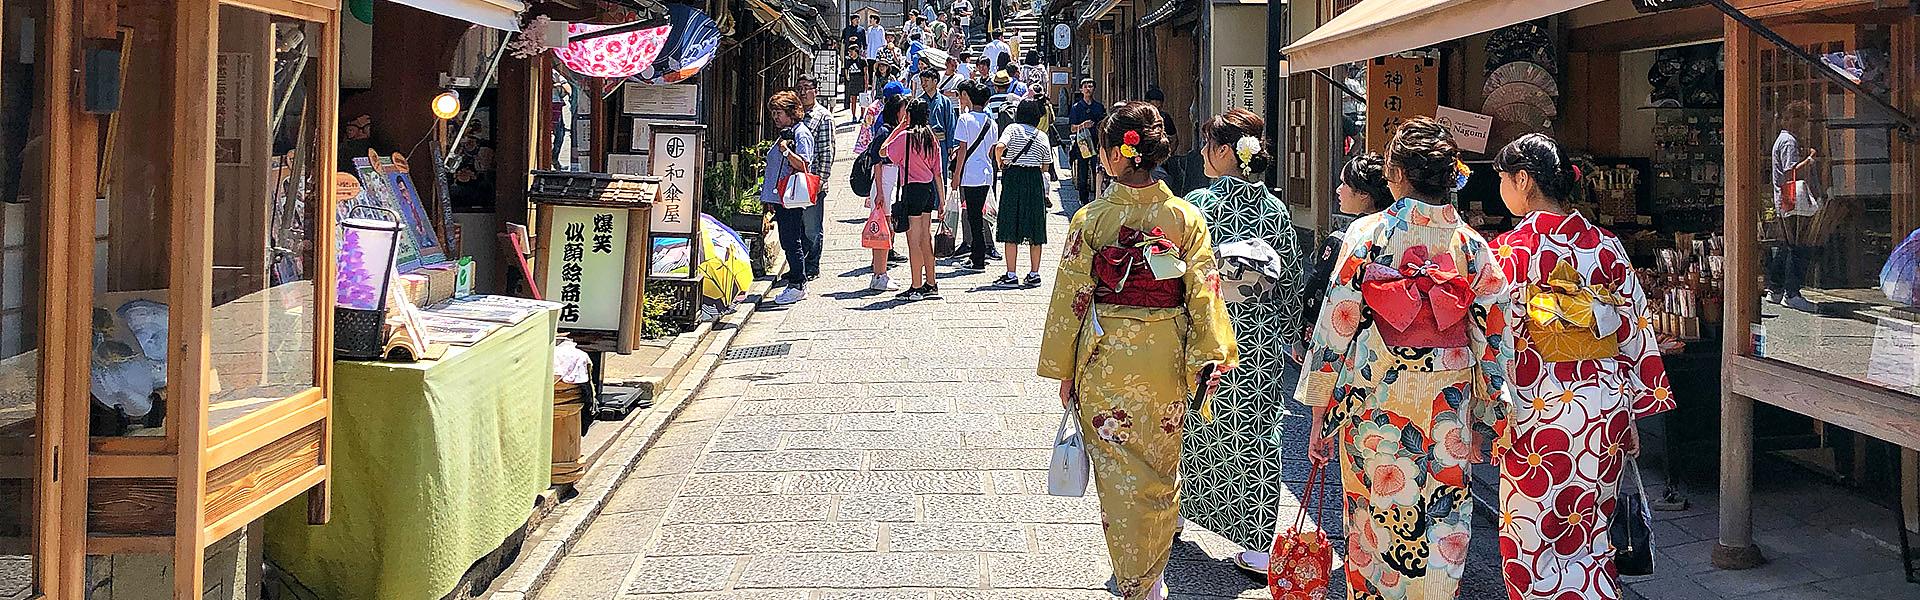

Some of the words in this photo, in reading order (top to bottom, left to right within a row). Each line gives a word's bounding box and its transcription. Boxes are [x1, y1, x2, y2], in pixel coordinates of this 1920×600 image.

[1453, 125, 1487, 139] Nagomi
[662, 163, 685, 223] 和傘屋
[592, 213, 614, 254] 爆笑
[559, 222, 585, 323] 似顔絵商店
